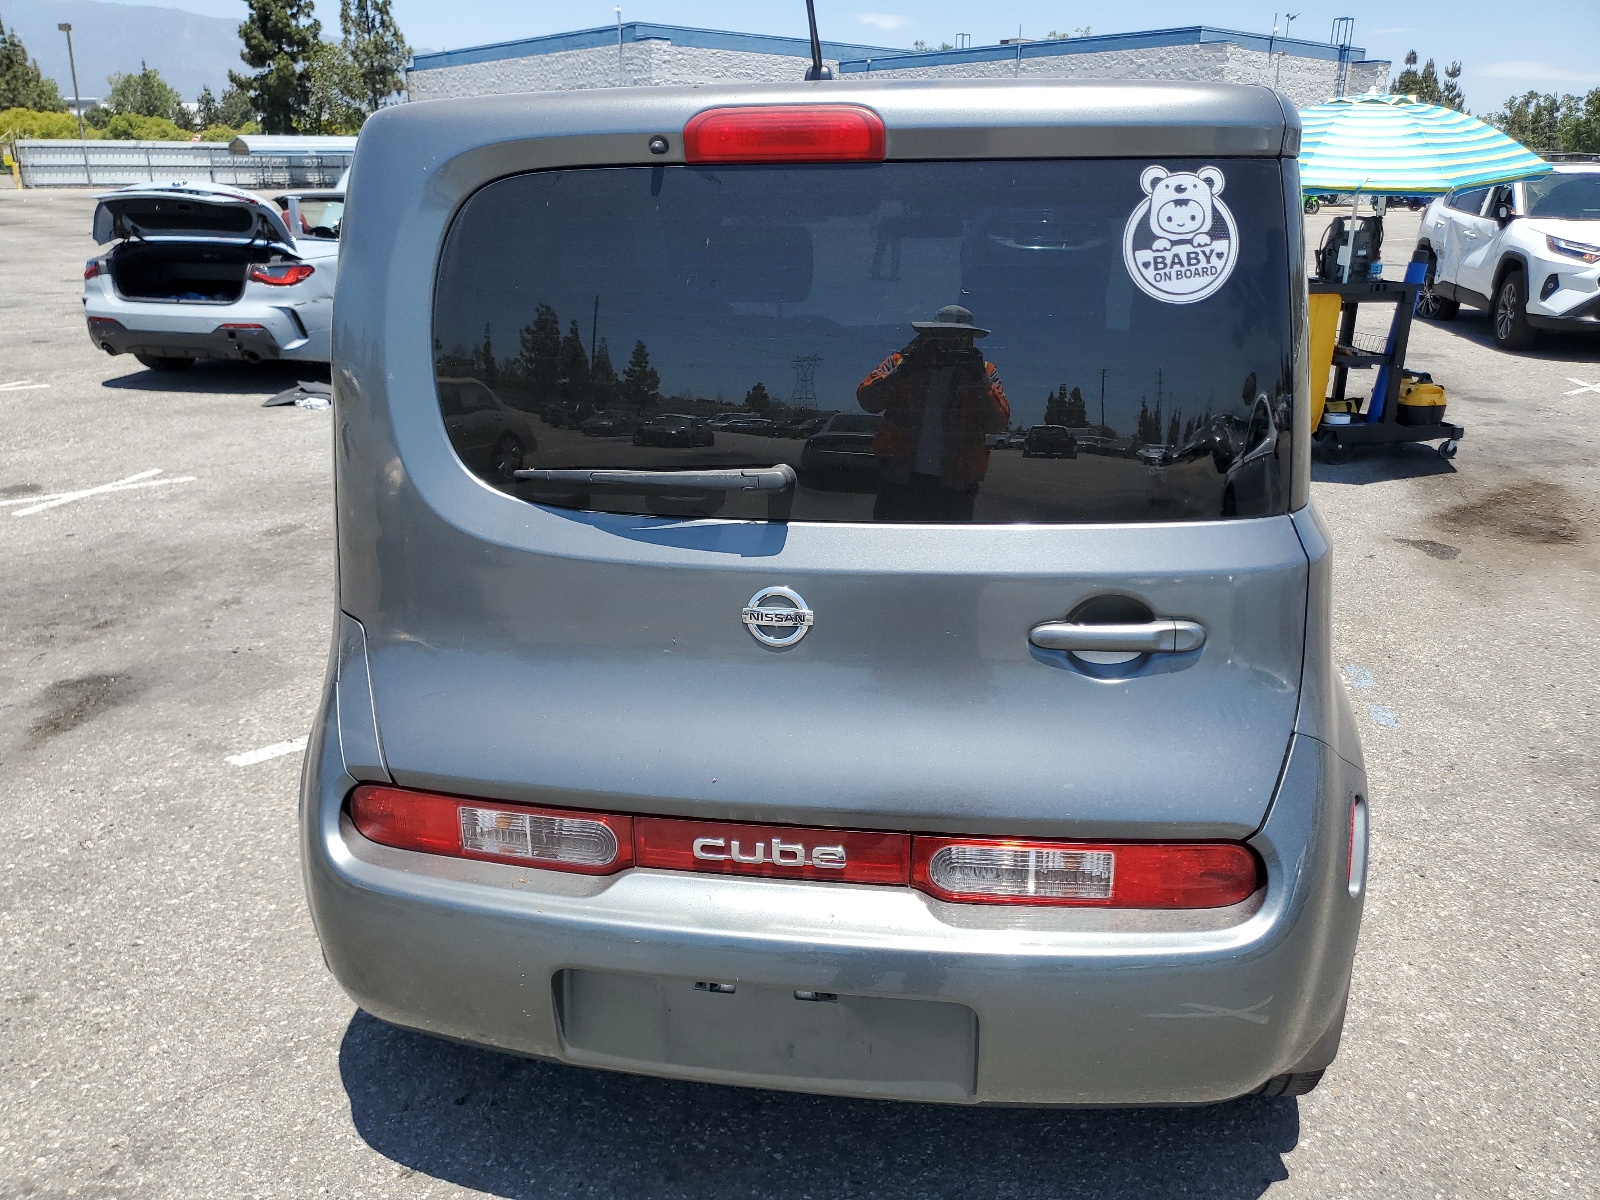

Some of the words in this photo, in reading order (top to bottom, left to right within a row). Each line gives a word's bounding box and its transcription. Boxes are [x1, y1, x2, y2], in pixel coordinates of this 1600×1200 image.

[1153, 249, 1215, 271] BABY
[1154, 272, 1172, 283] ON
[1175, 265, 1218, 281] BOARD
[749, 612, 805, 623] NISSAN
[692, 838, 847, 869] cube
